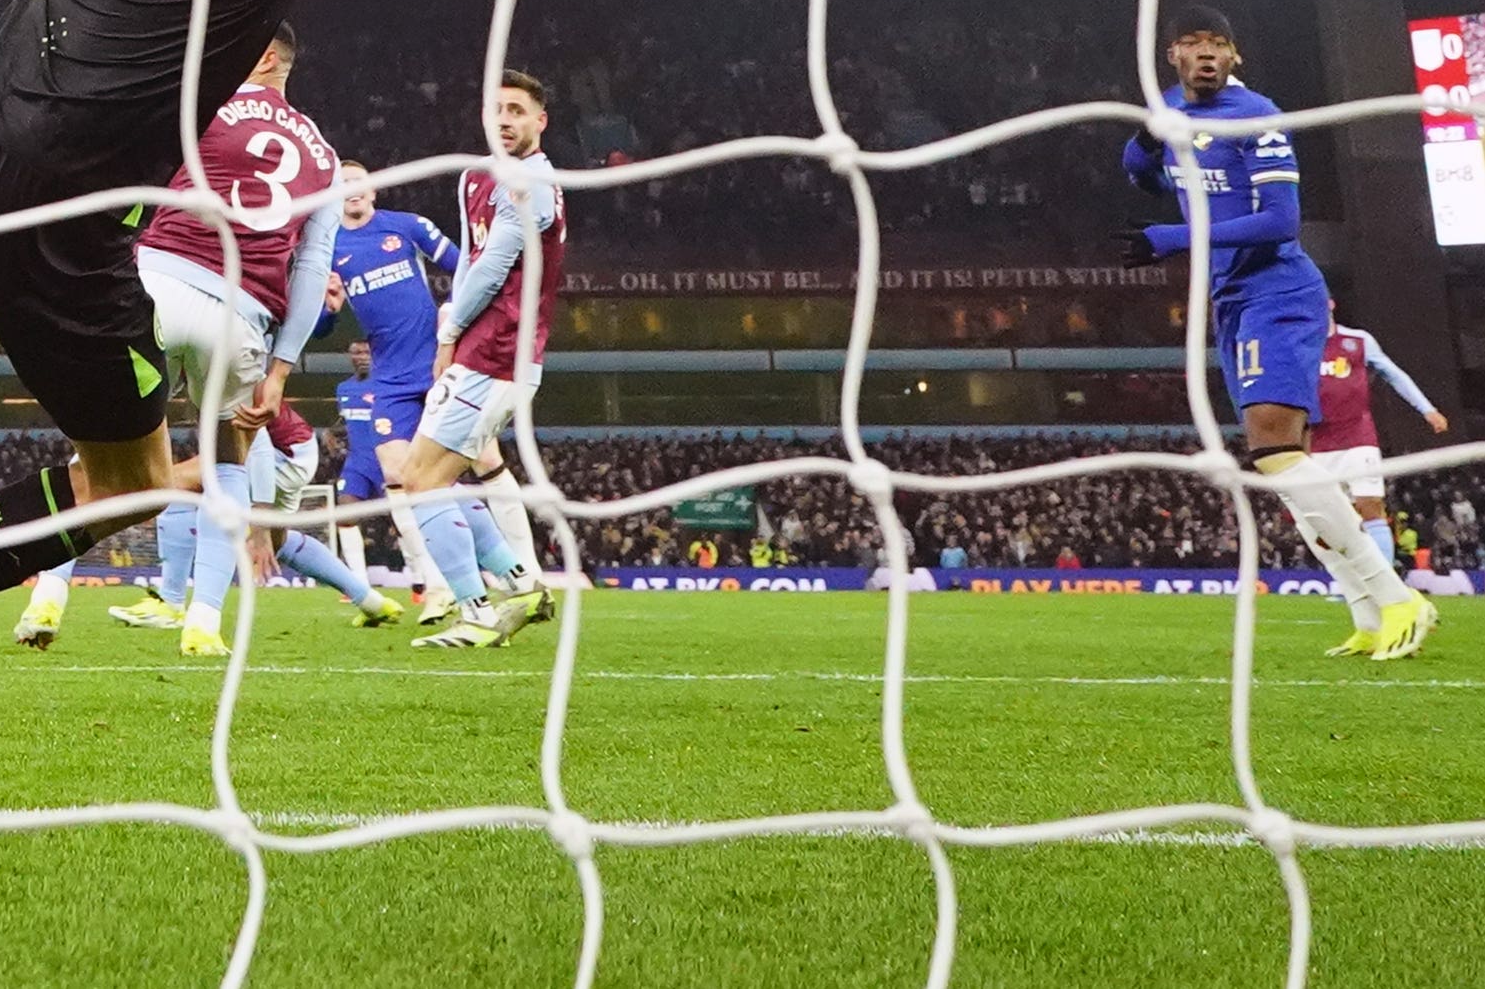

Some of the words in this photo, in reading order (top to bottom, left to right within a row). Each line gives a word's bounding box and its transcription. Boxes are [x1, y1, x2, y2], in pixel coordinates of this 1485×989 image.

[217, 99, 273, 126] DIEGO
[276, 108, 331, 170] CARLOS
[230, 131, 301, 232] 3
[673, 272, 700, 290] IT
[706, 271, 776, 290] MUST
[849, 270, 902, 289] AD
[910, 270, 936, 288] IT
[982, 268, 1061, 287] PETER
[970, 579, 1053, 593] PLAY
